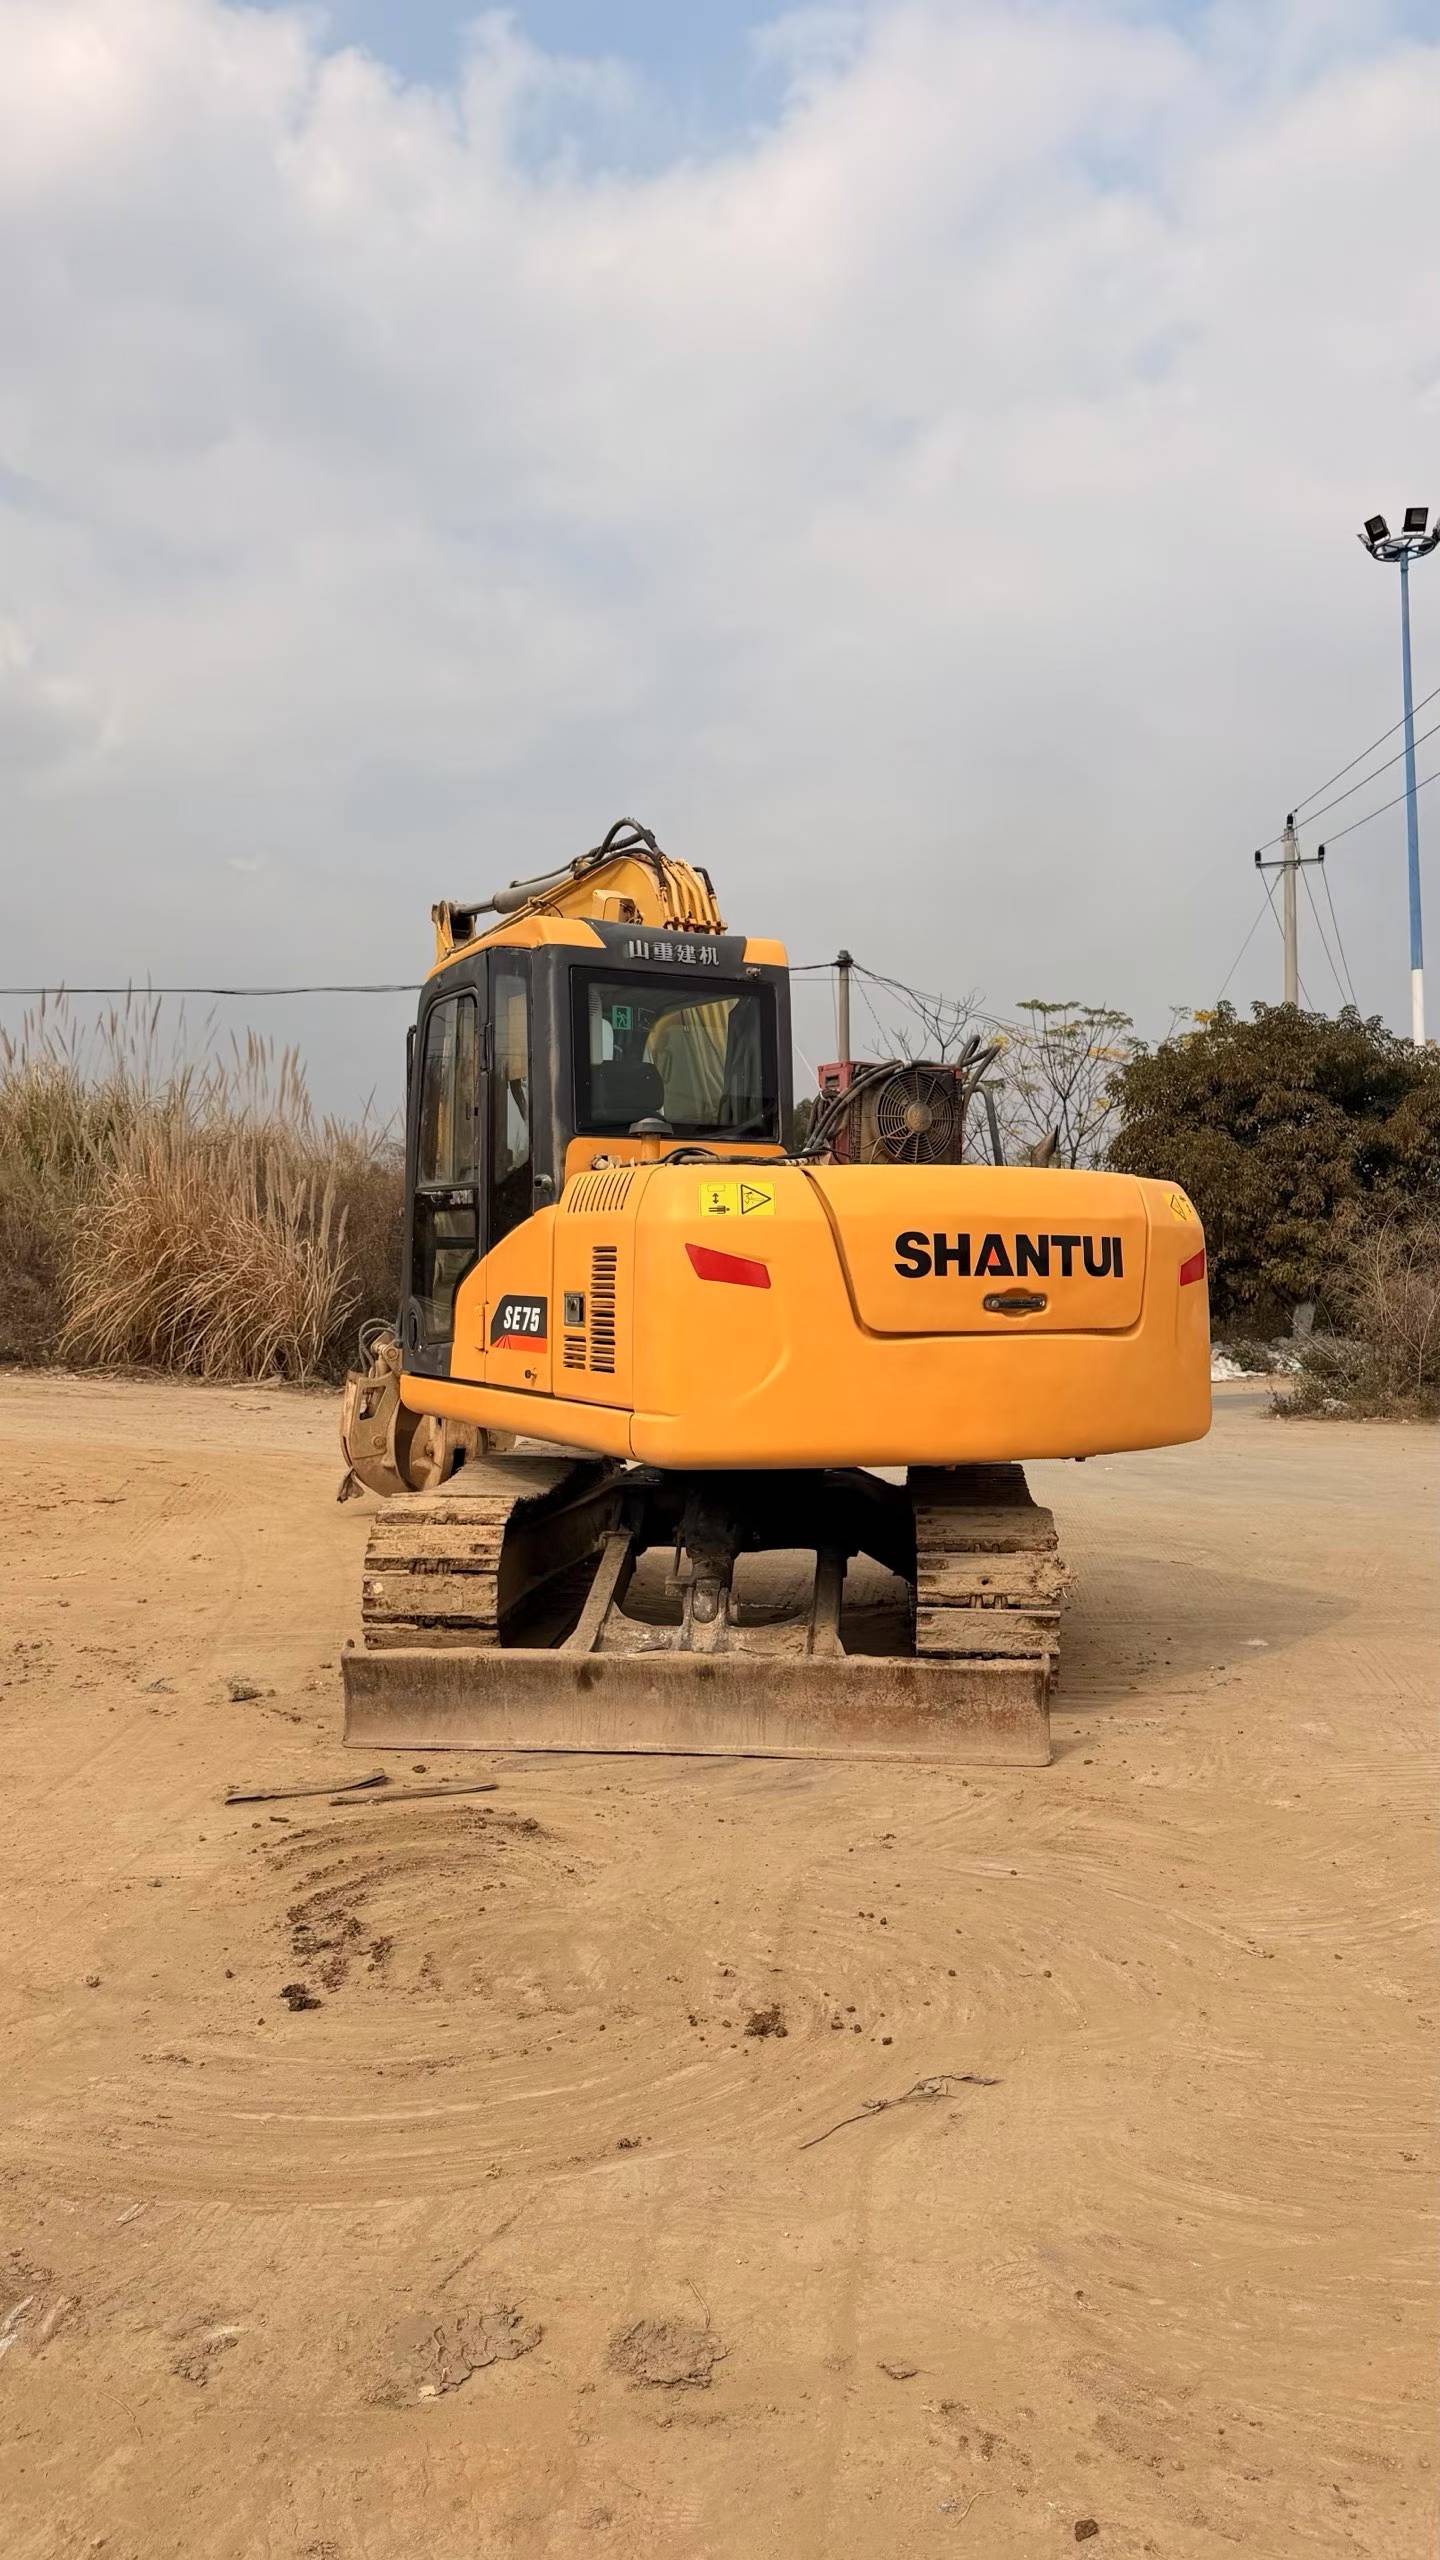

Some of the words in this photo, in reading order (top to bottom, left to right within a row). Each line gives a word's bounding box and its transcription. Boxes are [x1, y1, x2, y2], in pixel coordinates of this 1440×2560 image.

[628, 939, 720, 965] 山重建机
[894, 1231, 1124, 1278] SHANTUI
[503, 1305, 541, 1332] SE75
